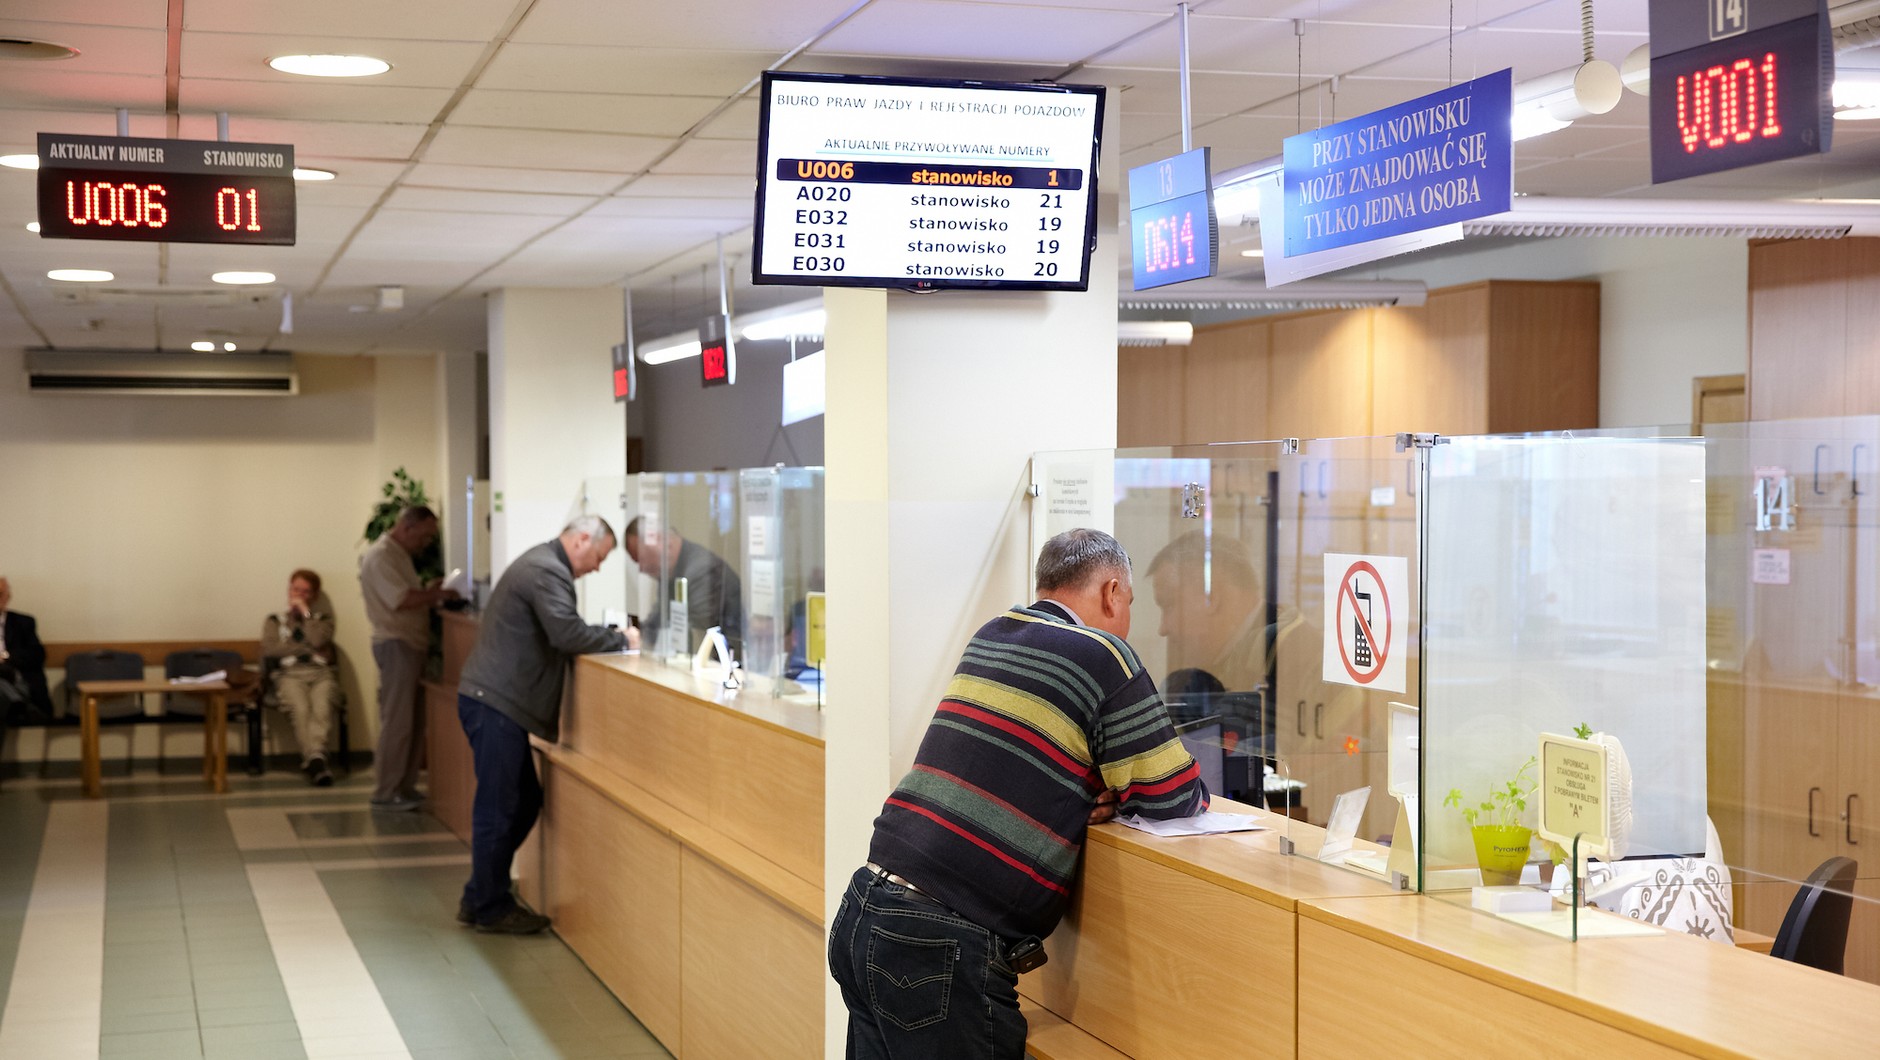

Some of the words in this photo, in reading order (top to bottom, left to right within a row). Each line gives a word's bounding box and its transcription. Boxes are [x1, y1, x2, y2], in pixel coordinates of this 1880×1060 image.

[777, 94, 820, 107] BIURO
[826, 96, 867, 108] PRAW
[873, 99, 913, 110] JAZDY
[930, 101, 1007, 114] REJESTRACJI
[1677, 52, 1782, 154] V001
[1312, 133, 1354, 168] PRZY
[1358, 96, 1471, 155] STANOWISKU
[50, 143, 115, 162] AKTUALNY
[119, 147, 164, 163] NUMER
[203, 151, 284, 169] STANOWISKO
[824, 138, 891, 151] AKTUALNIE
[895, 141, 996, 155] PRZYWOŁYWANE
[999, 145, 1051, 157] NUMERY
[797, 161, 855, 180] U006
[911, 169, 1014, 186] stanowisko
[1047, 170, 1059, 187] 1
[1160, 163, 1173, 197] 13
[1299, 168, 1345, 206] MOŻE
[1349, 133, 1455, 194] ZNAJDOWAĆ
[1458, 132, 1487, 169] SIĘ
[67, 180, 167, 228] U006
[217, 187, 262, 231] 01
[796, 186, 851, 202] A020
[911, 194, 1010, 209] stanowisko
[1040, 194, 1063, 209] 21
[1304, 204, 1359, 240] TYLKO
[1362, 191, 1416, 227] JEDNA
[1420, 175, 1481, 214] OSOBA
[796, 209, 848, 225] E032
[909, 217, 1008, 232] stanowisko
[1039, 217, 1062, 231] 19
[794, 233, 845, 249] E031
[907, 240, 1006, 254] stanowisko
[1037, 240, 1060, 254] 19
[793, 256, 845, 272] E030
[905, 263, 1004, 277] stanowisko
[1034, 262, 1058, 277] 20
[1753, 476, 1792, 532] 14
[1580, 792, 1599, 805] BILETEM
